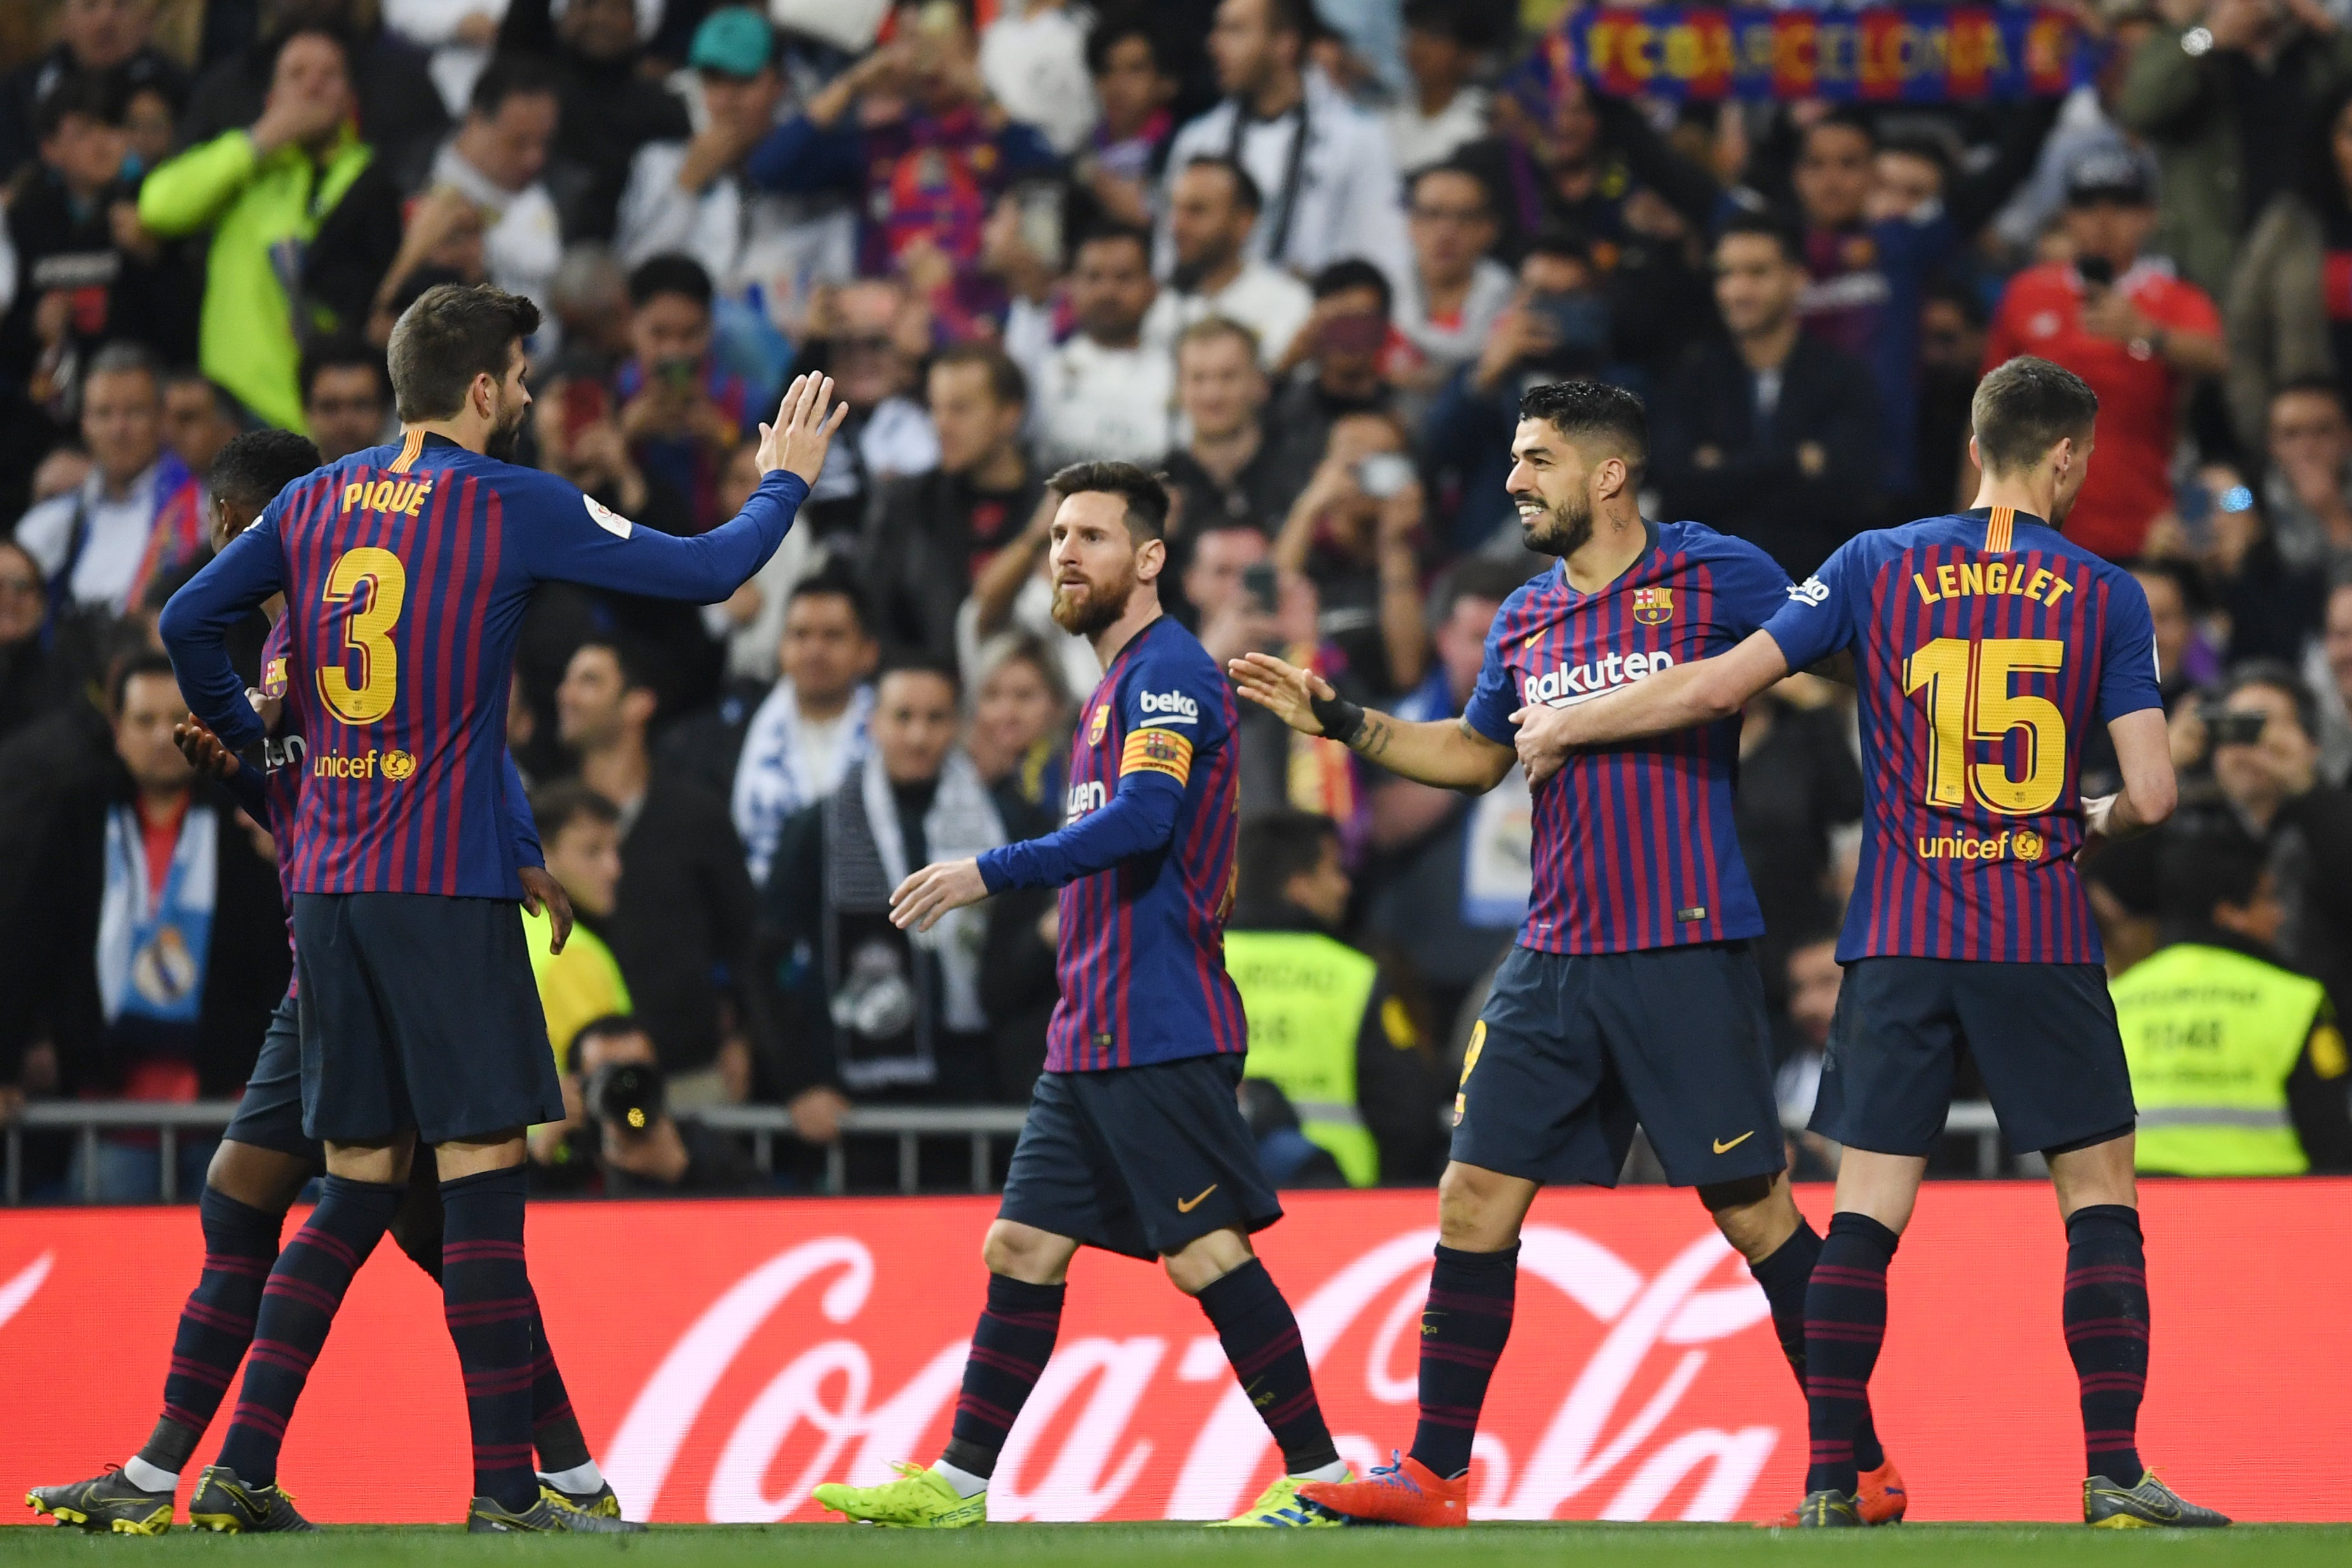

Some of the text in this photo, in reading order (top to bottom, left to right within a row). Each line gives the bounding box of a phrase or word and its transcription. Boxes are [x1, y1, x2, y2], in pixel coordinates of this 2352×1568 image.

[342, 480, 433, 517] PIQUÉ
[1912, 562, 2074, 607] LENGLET
[314, 546, 407, 726] 3
[1524, 651, 1674, 707] Rakuten
[1140, 689, 1198, 717] beko
[1902, 637, 2067, 816] 15
[314, 749, 378, 779] unicef
[1917, 830, 2010, 860] unicef
